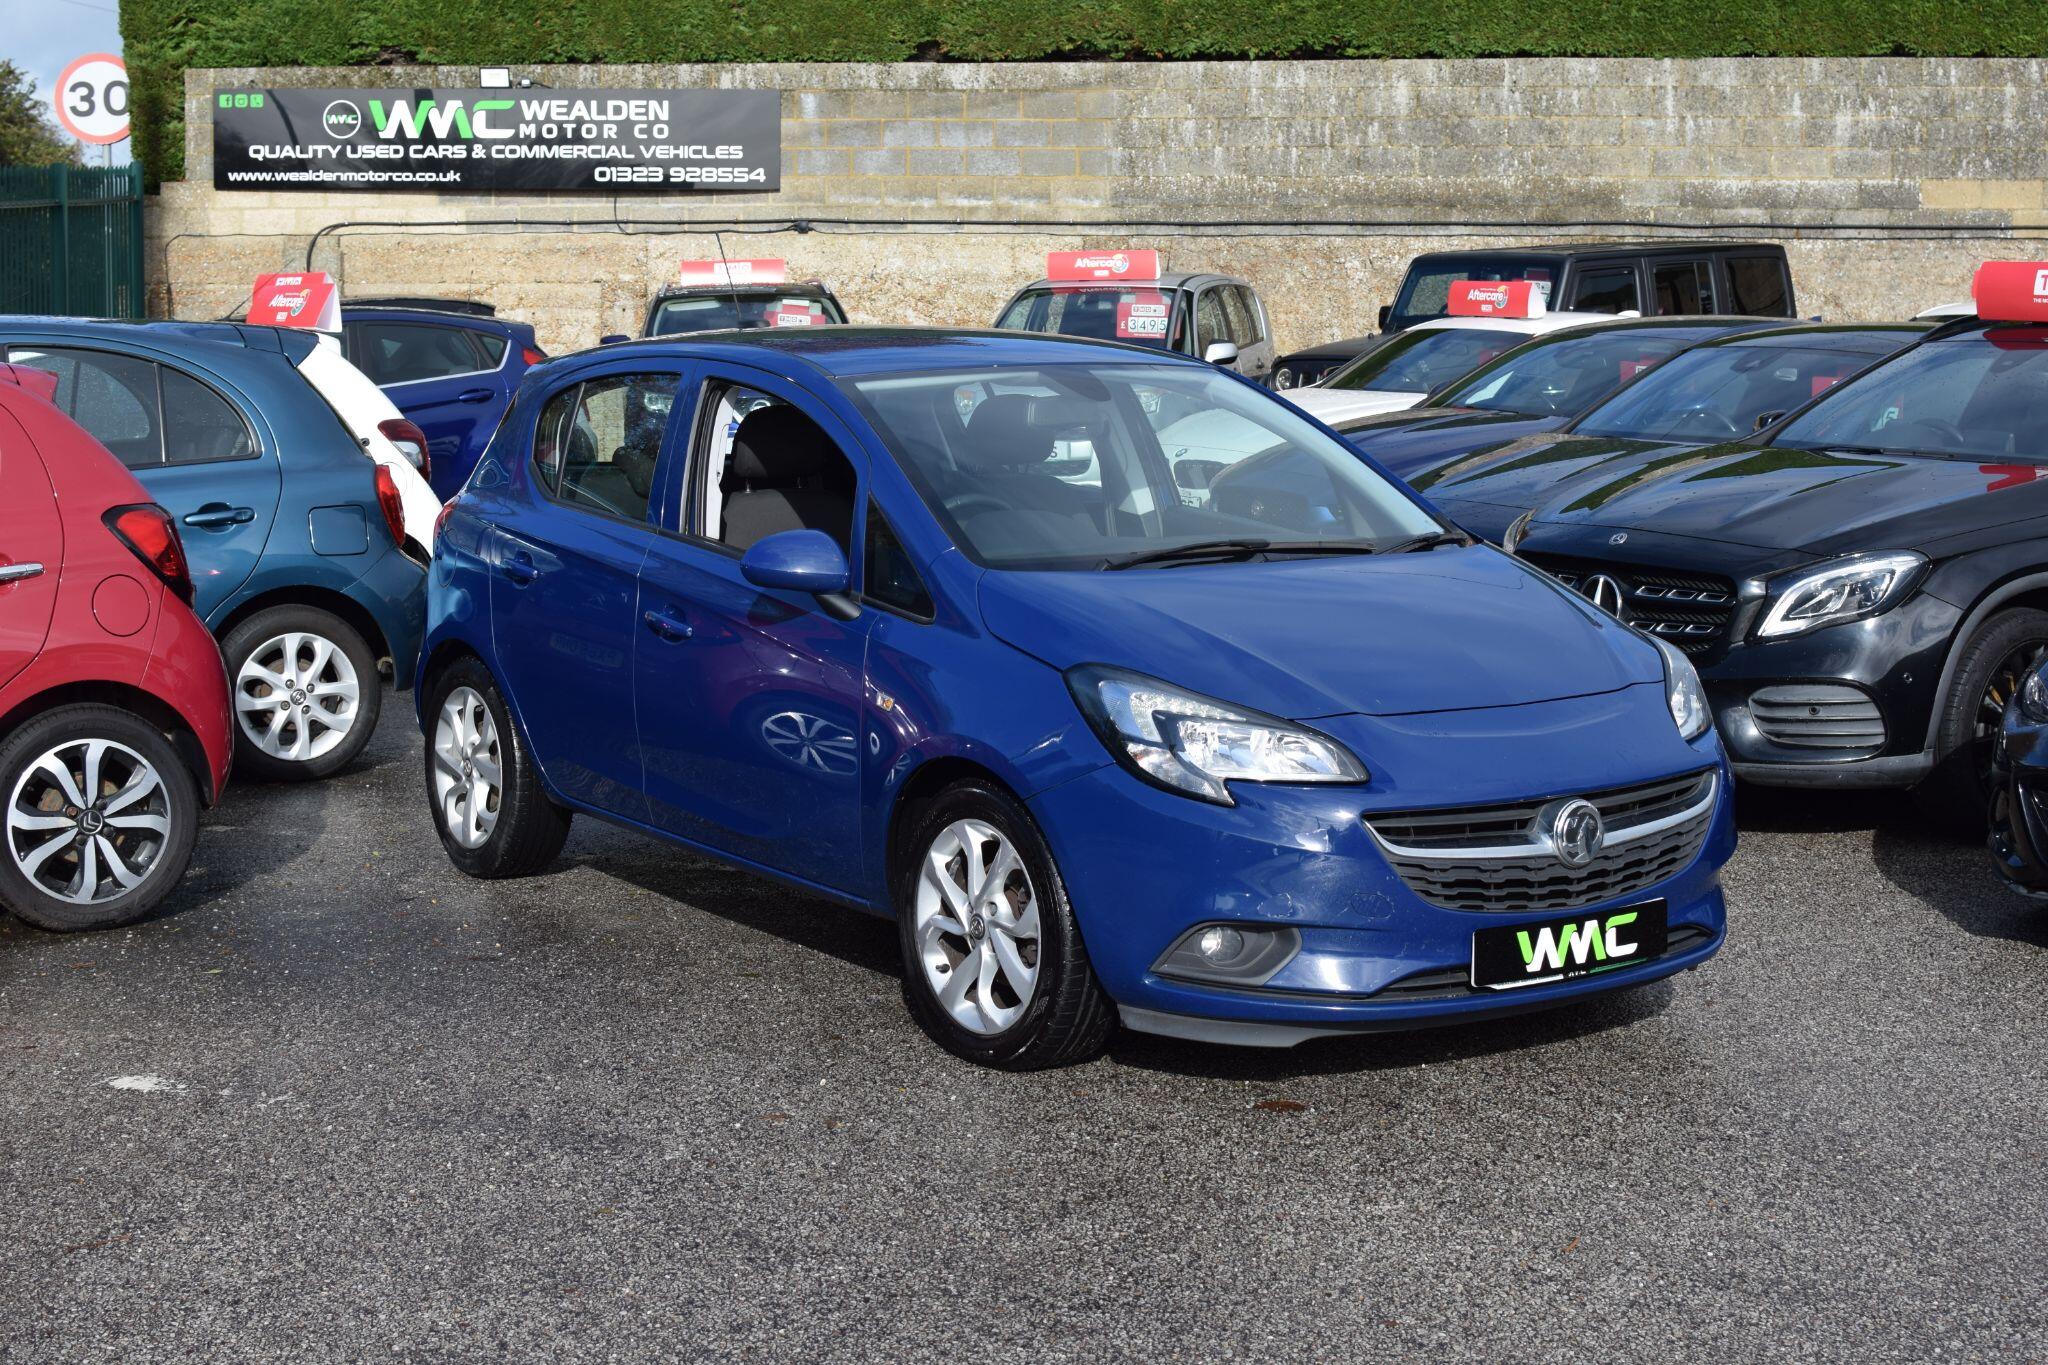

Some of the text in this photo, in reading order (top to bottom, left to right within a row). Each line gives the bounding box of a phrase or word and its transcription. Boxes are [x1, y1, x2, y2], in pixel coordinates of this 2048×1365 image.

[69, 80, 130, 117] 30
[519, 99, 670, 121] WEALDEN
[367, 100, 516, 139] WMC
[519, 123, 670, 139] MOTOR CO
[248, 144, 744, 161] QUALITY USED CARS & COMMERCIAL VEHICLES
[227, 169, 461, 182] www.wealdenmotorco.co.uk
[594, 166, 766, 183] 01323 928554
[1074, 258, 1123, 268] Aftercare
[1467, 289, 1504, 301] Aftercare
[1516, 911, 1638, 972] WMC
